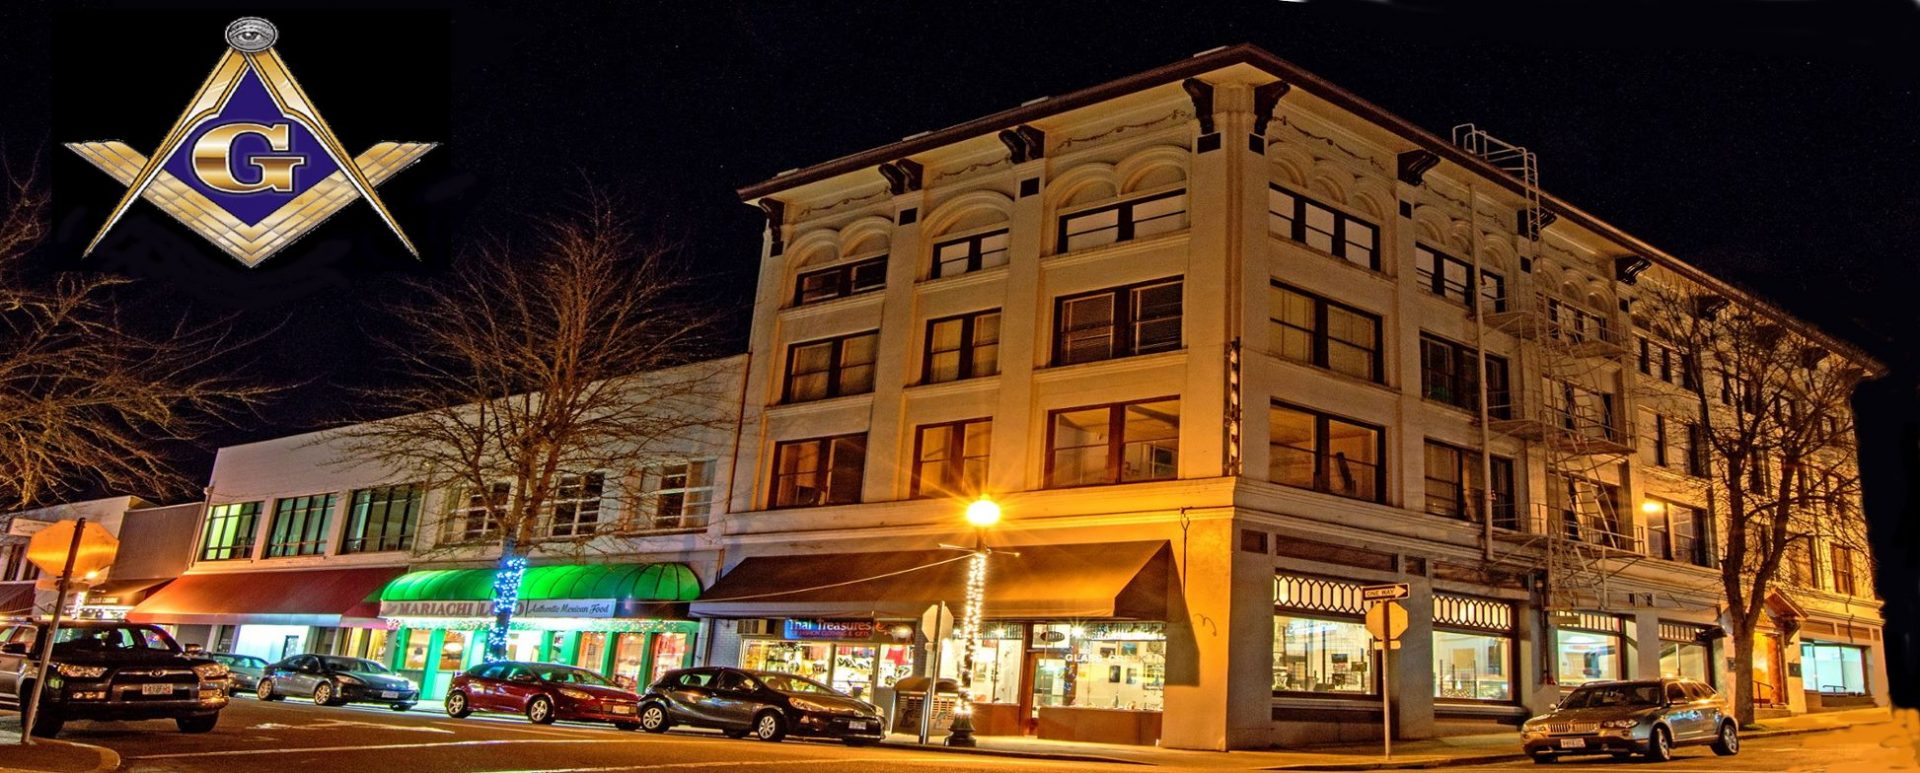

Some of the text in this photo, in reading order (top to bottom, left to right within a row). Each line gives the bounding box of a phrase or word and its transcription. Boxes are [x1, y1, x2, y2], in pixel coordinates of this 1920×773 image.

[399, 601, 525, 617] MARIACHI LOO
[561, 603, 589, 613] Mexican
[590, 603, 610, 614] Food
[789, 619, 871, 630] Thai Treasures
